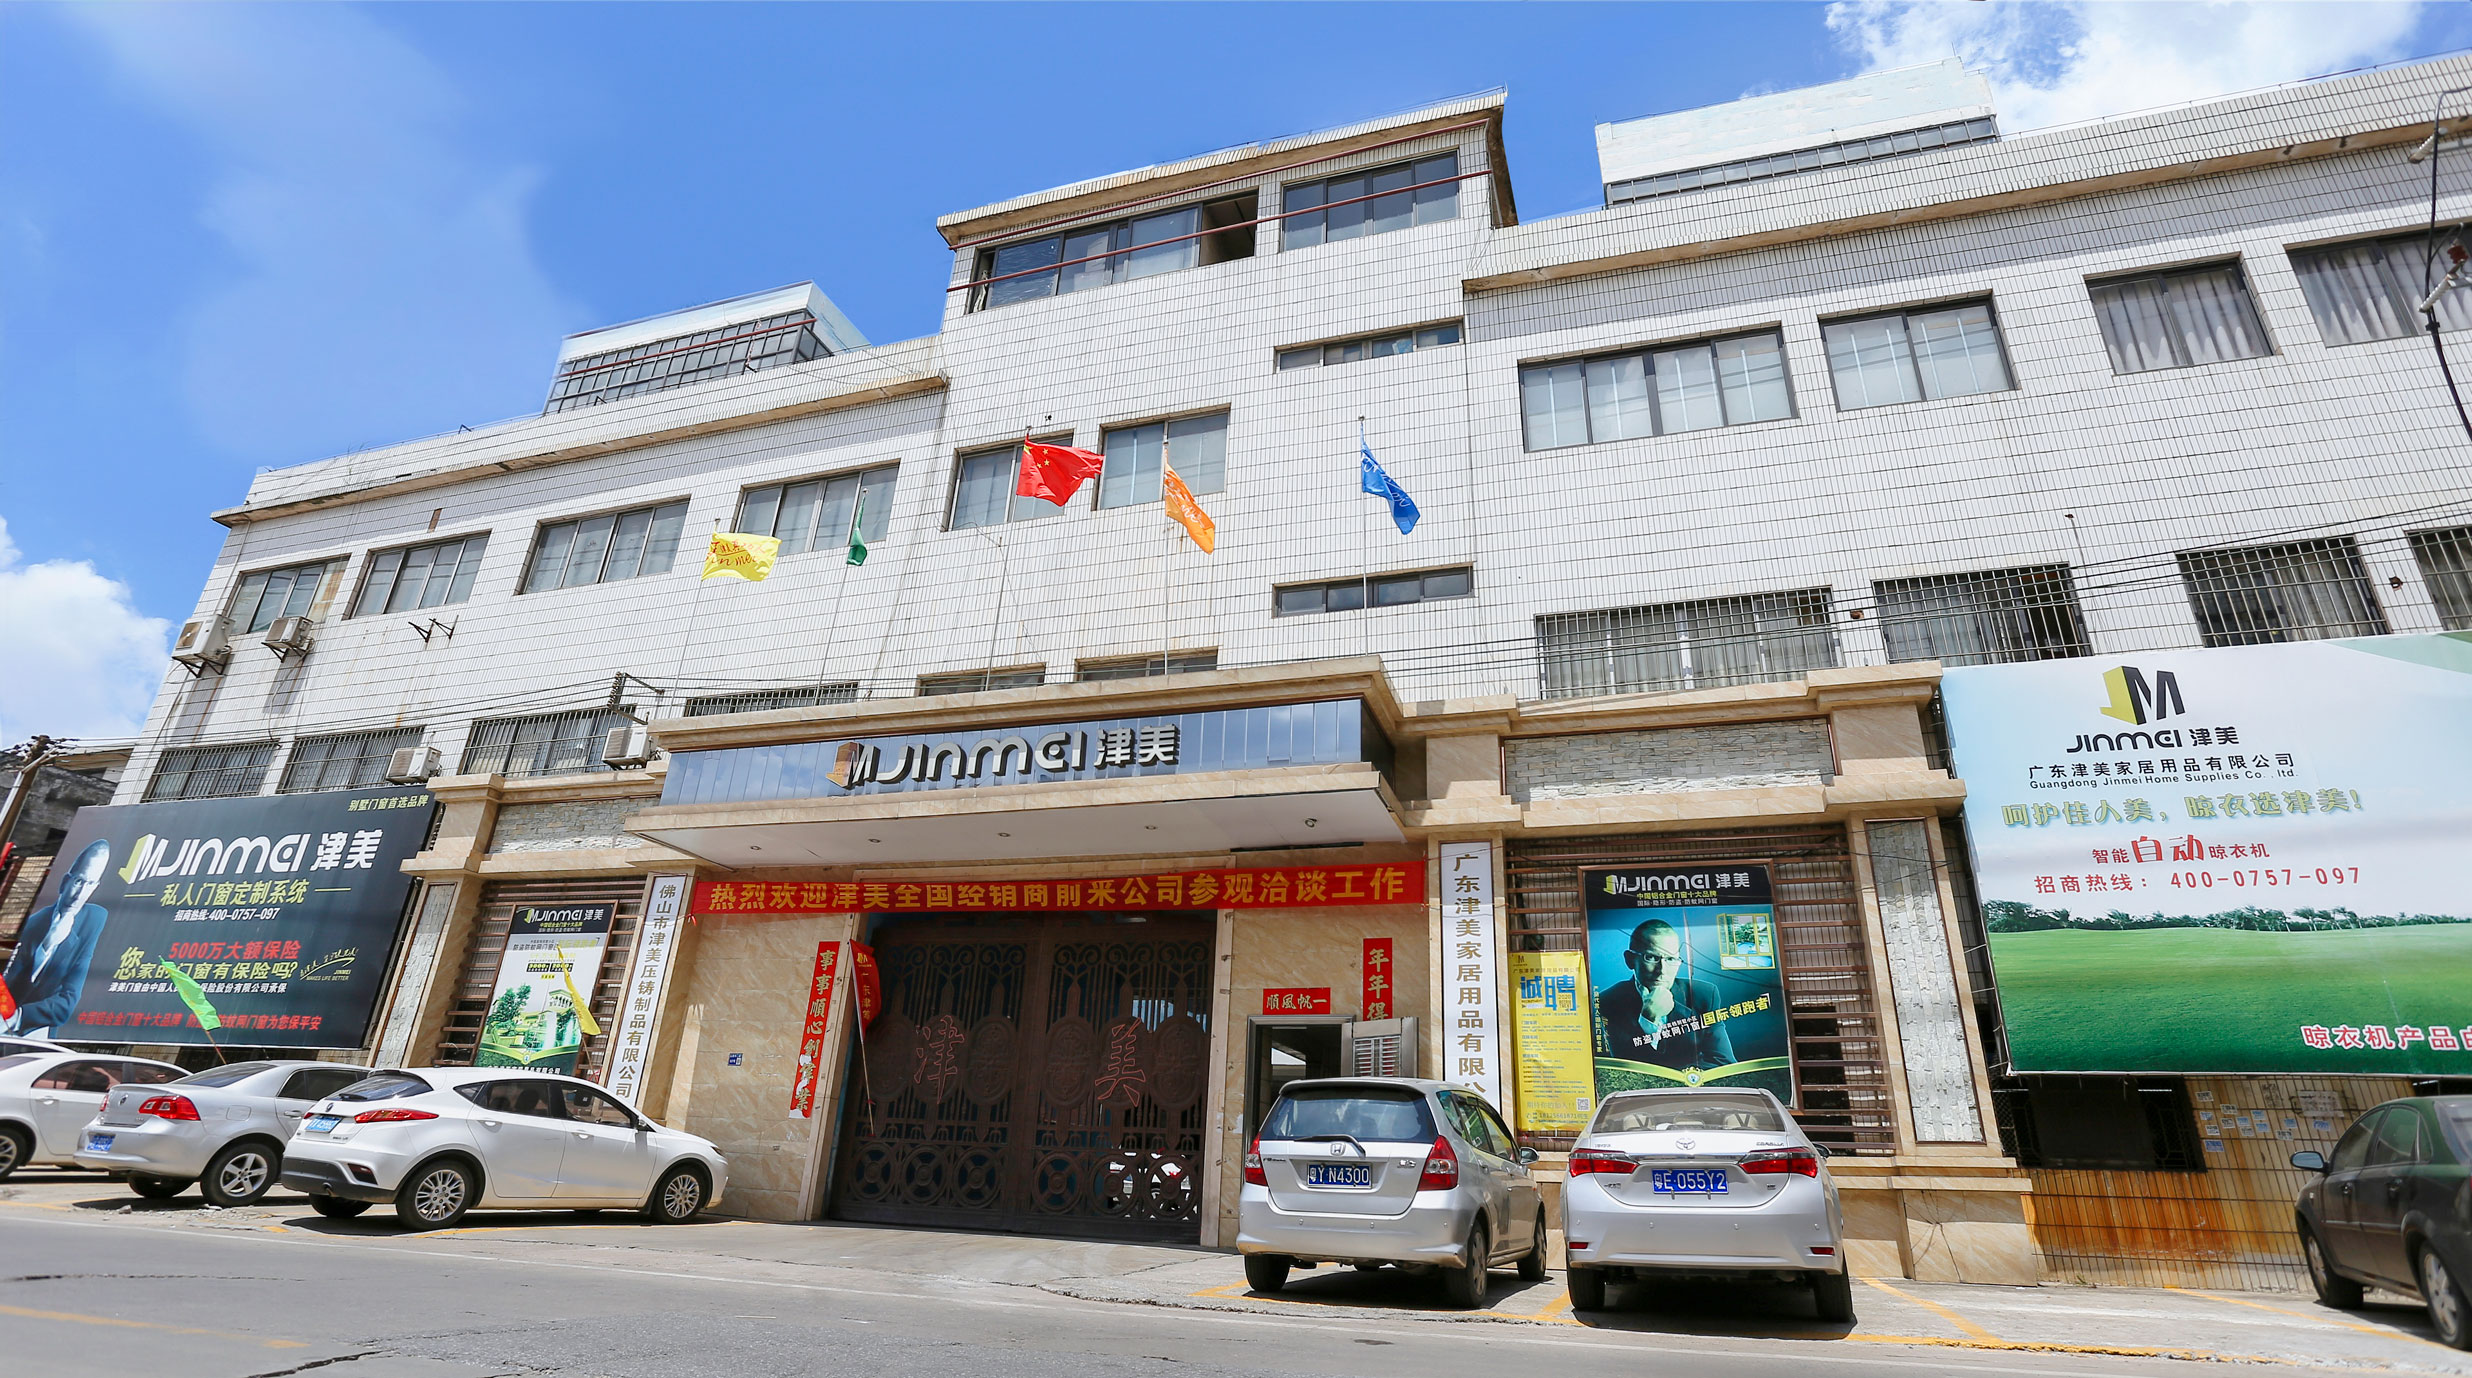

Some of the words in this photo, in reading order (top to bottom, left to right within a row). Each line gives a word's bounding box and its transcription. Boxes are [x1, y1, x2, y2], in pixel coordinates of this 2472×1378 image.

[1093, 723, 1182, 767] 津美
[2188, 726, 2240, 747] 津美
[2028, 753, 2295, 779] 广东津美家居用品有限公司
[2029, 778, 2098, 790] Guangdong
[2185, 770, 2240, 783] Supplies
[347, 794, 429, 811] 别墅门窗首选品牌
[310, 829, 383, 871] 津美
[2092, 834, 2270, 865] 智能自动晾衣机
[1715, 873, 1750, 889] 津美
[2171, 866, 2360, 889] 400-0757-097
[160, 878, 309, 907] 私人门窗定制系统
[1637, 891, 1717, 900] 中国铝合金门窗十大品牌
[584, 909, 604, 920] 津美
[168, 940, 301, 961] 5000万大额保险
[615, 884, 677, 1099] 佛山市津美压铸制品有限公司
[1520, 975, 1576, 1011] 诚聘
